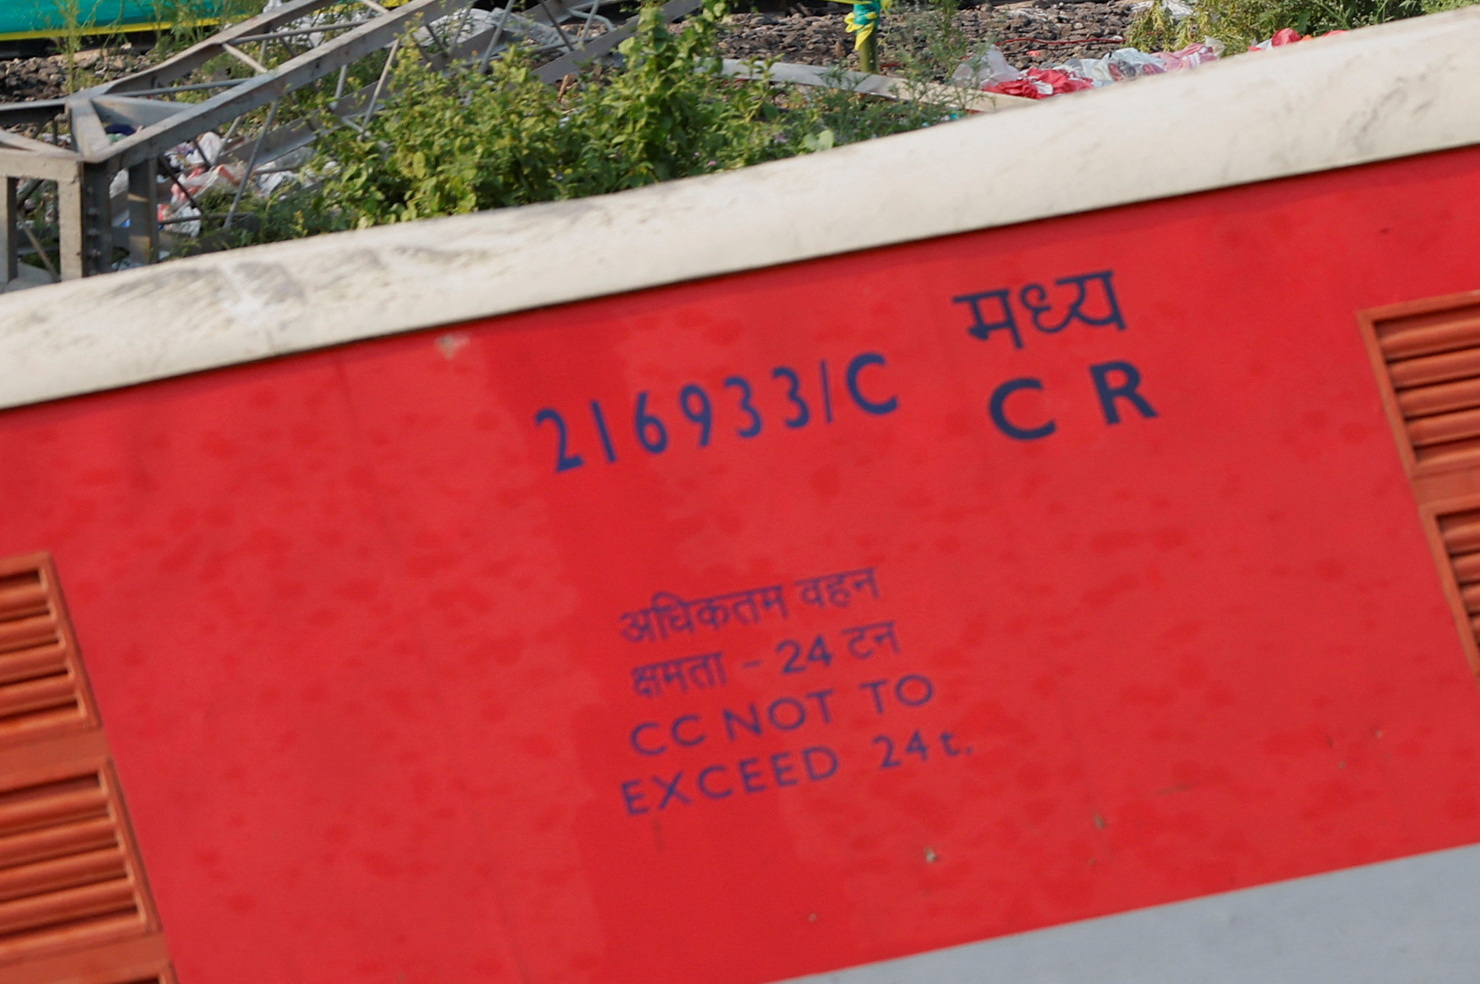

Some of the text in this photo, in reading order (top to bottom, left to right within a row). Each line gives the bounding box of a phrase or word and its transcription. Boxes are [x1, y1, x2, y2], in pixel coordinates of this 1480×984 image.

[952, 269, 1127, 350] मध्य
[535, 352, 898, 473] 216933/C
[618, 566, 881, 645] अधिकतम वहन
[630, 649, 729, 700] क्षमता
[776, 634, 836, 676] 24
[840, 619, 902, 661] टन
[721, 689, 837, 740] NOT
[859, 673, 936, 715] TO
[619, 745, 839, 817] EXCEED
